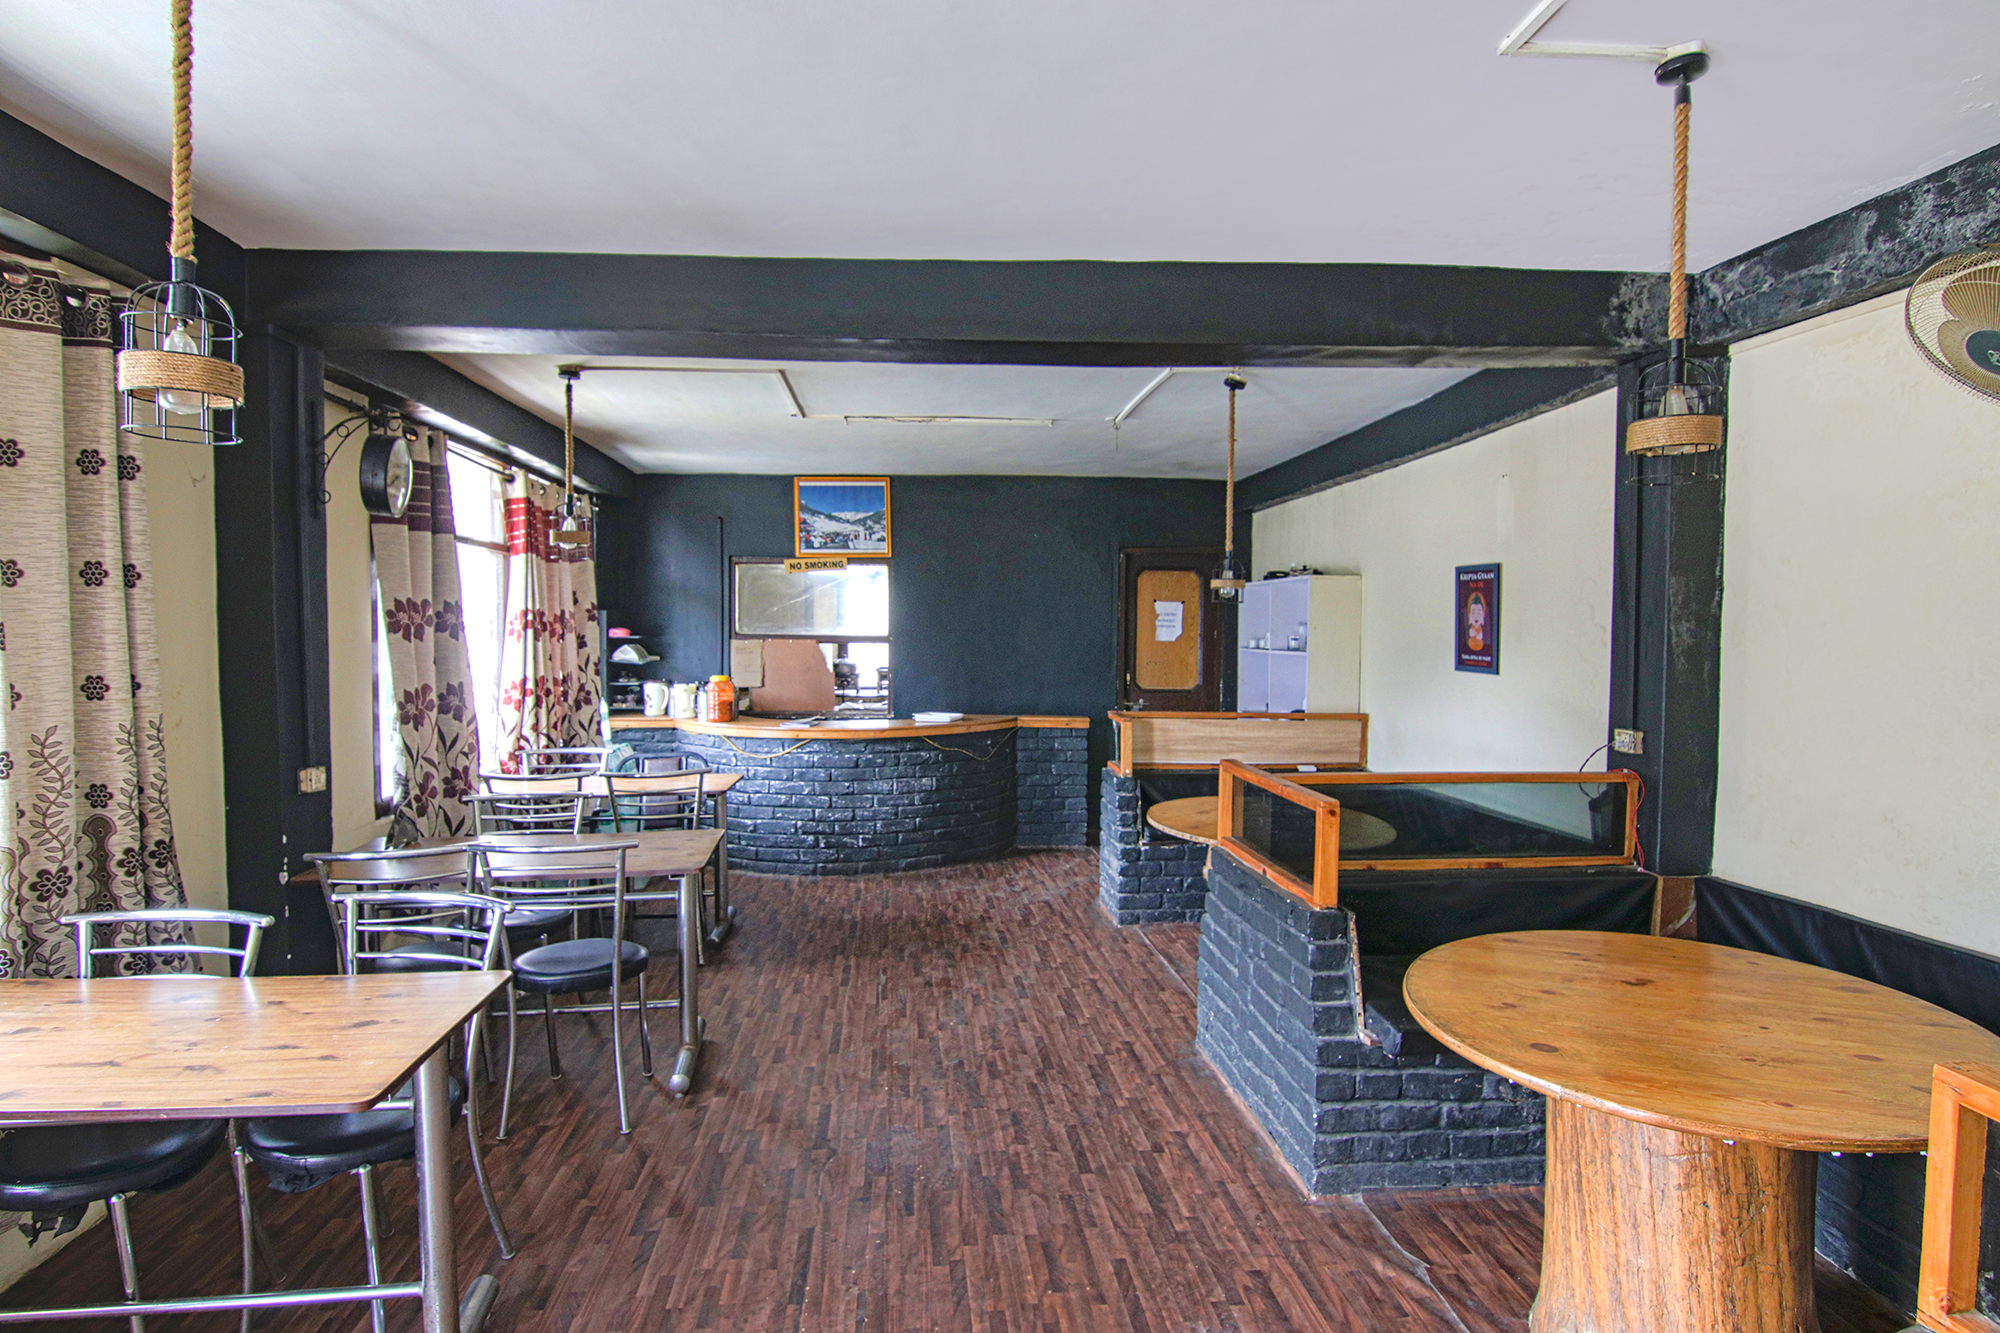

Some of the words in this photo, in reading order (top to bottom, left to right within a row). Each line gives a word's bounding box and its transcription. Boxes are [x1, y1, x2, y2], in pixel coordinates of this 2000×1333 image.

[790, 562, 802, 570] NO
[804, 560, 844, 570] SMOKING
[1477, 572, 1494, 580] GYAAN
